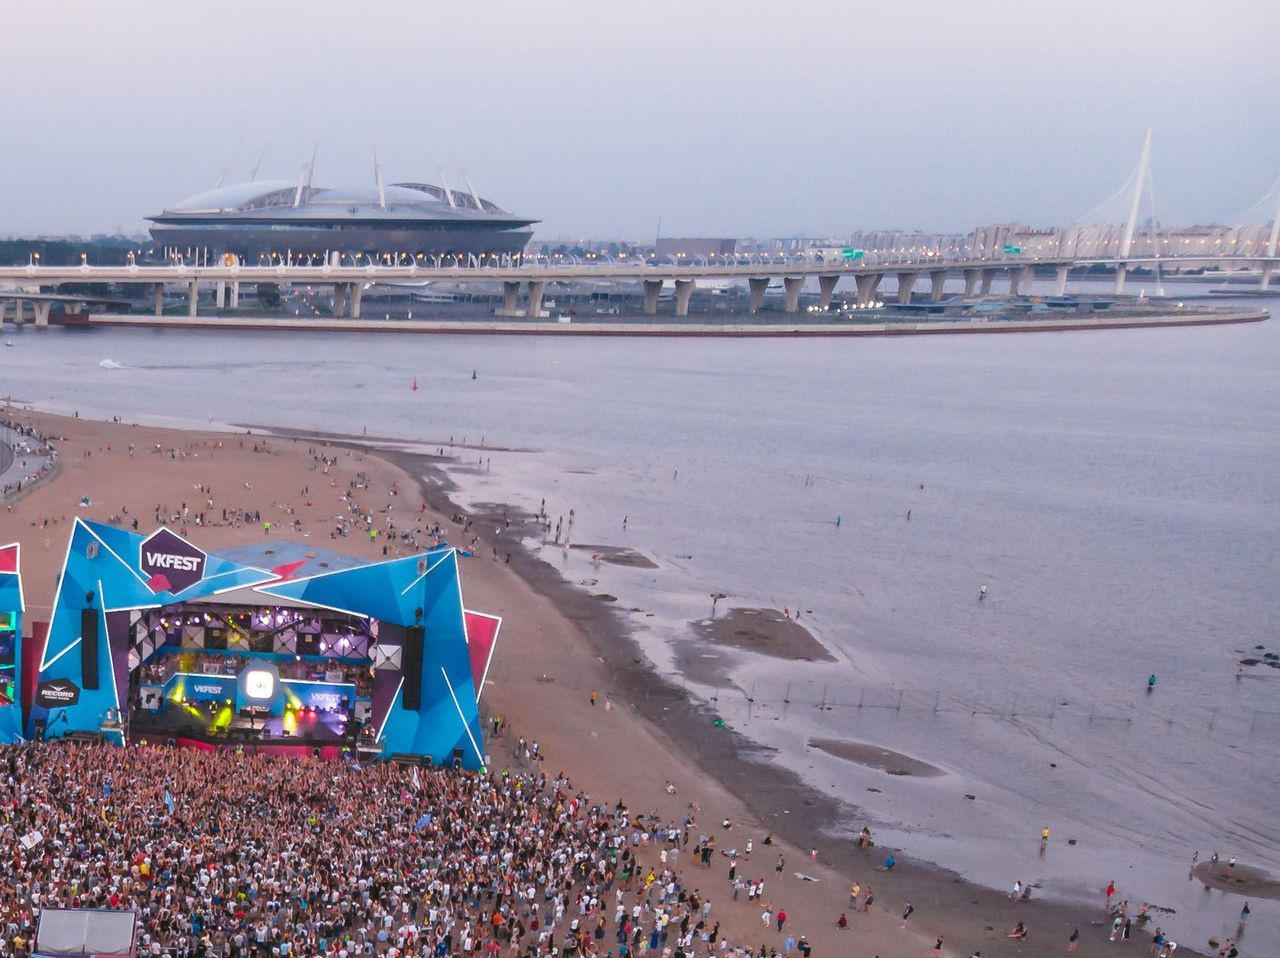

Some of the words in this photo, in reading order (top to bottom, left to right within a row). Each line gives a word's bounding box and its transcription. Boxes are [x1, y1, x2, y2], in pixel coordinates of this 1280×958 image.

[146, 552, 201, 571] VKFEST
[41, 689, 74, 698] RECORD
[194, 685, 222, 694] VKFEST
